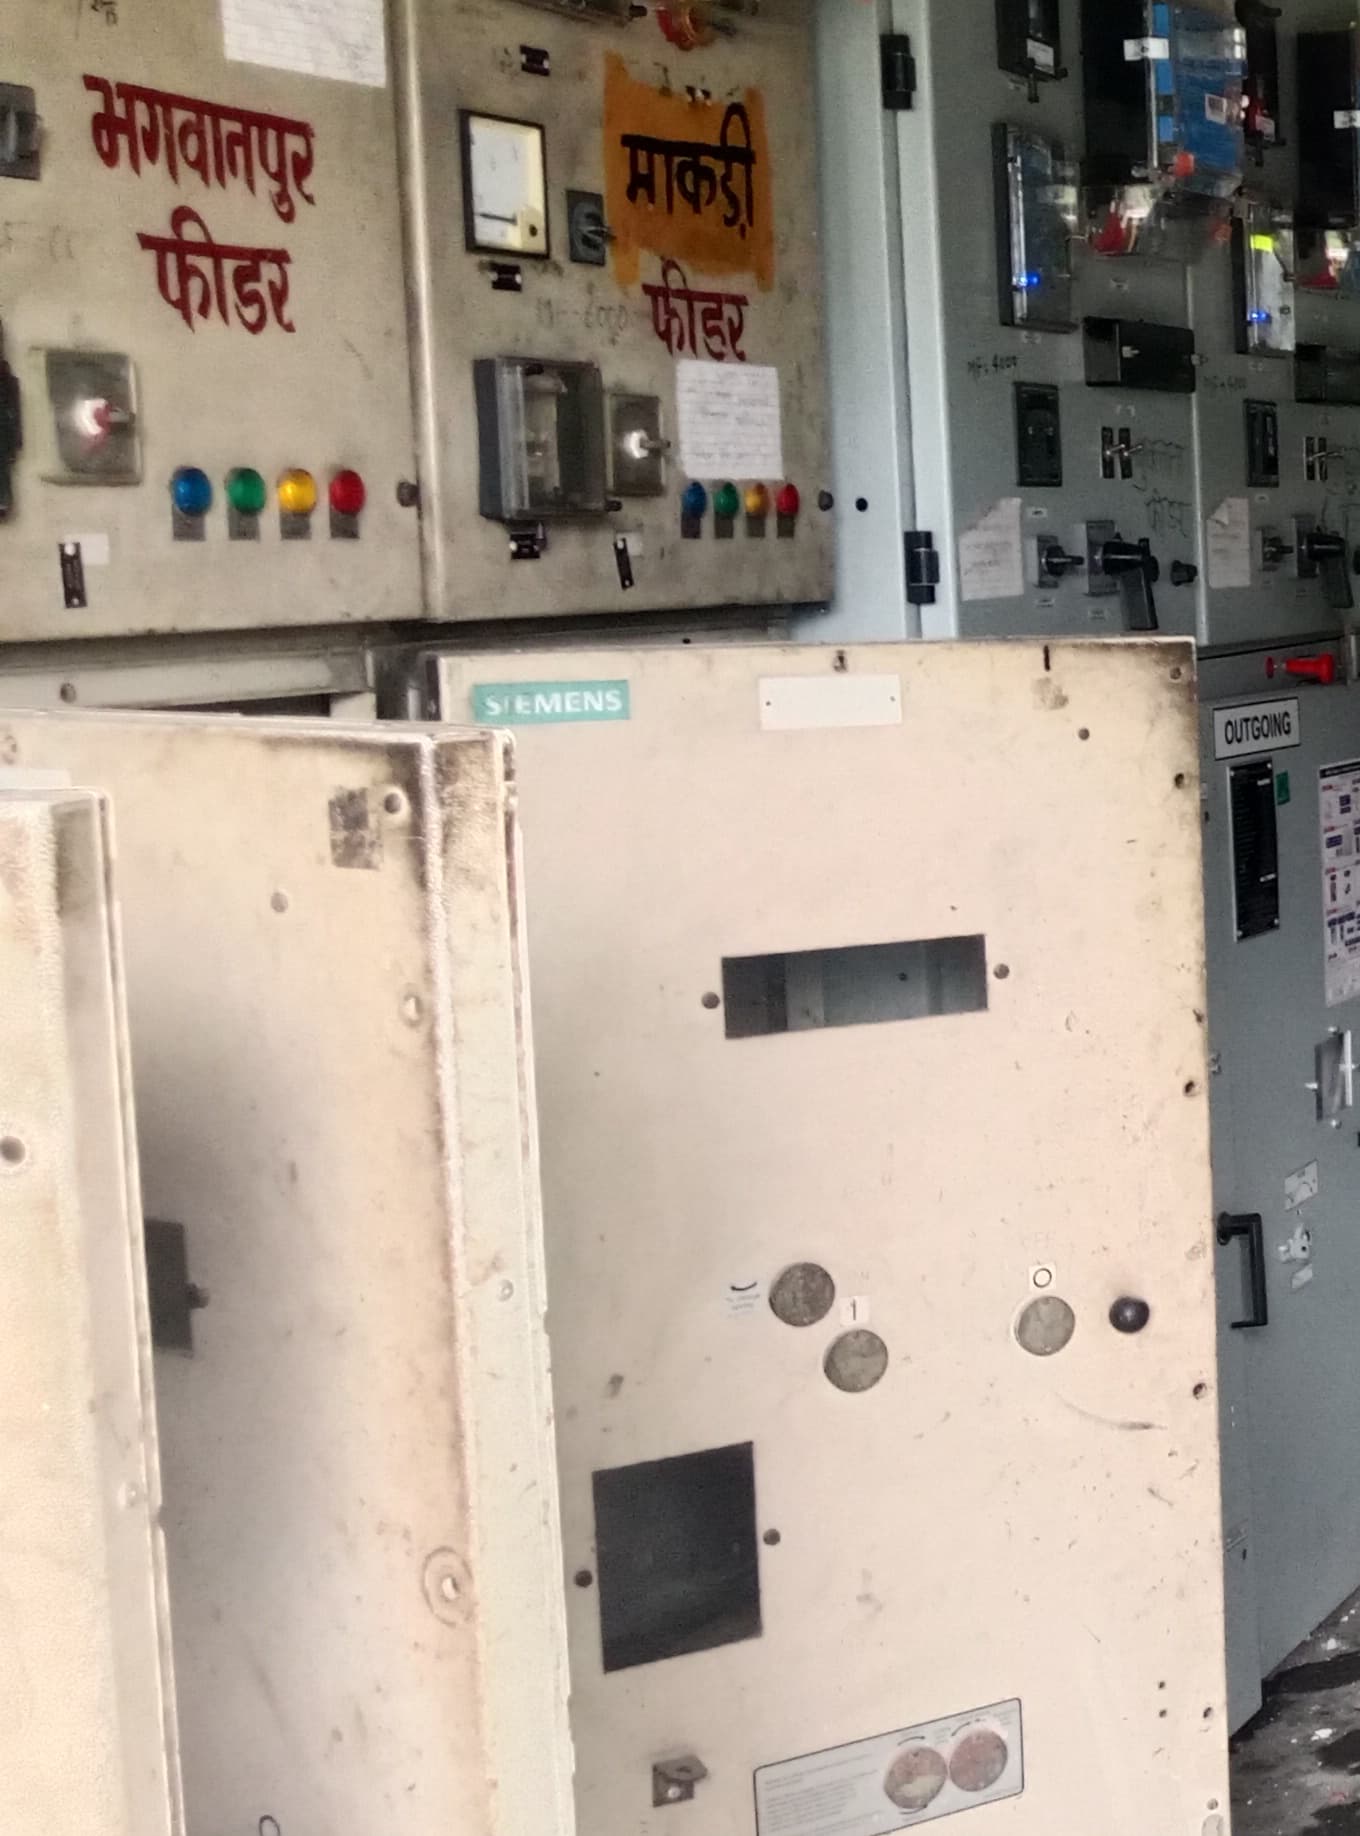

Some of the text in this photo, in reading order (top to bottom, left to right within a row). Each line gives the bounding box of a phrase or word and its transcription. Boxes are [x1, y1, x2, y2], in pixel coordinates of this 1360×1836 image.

[82, 74, 316, 224] भगवानपुर
[136, 205, 296, 335] फीडर
[642, 257, 749, 362] फीडर
[485, 689, 623, 716] SIEMENS
[1225, 711, 1292, 745] OUTGOING
